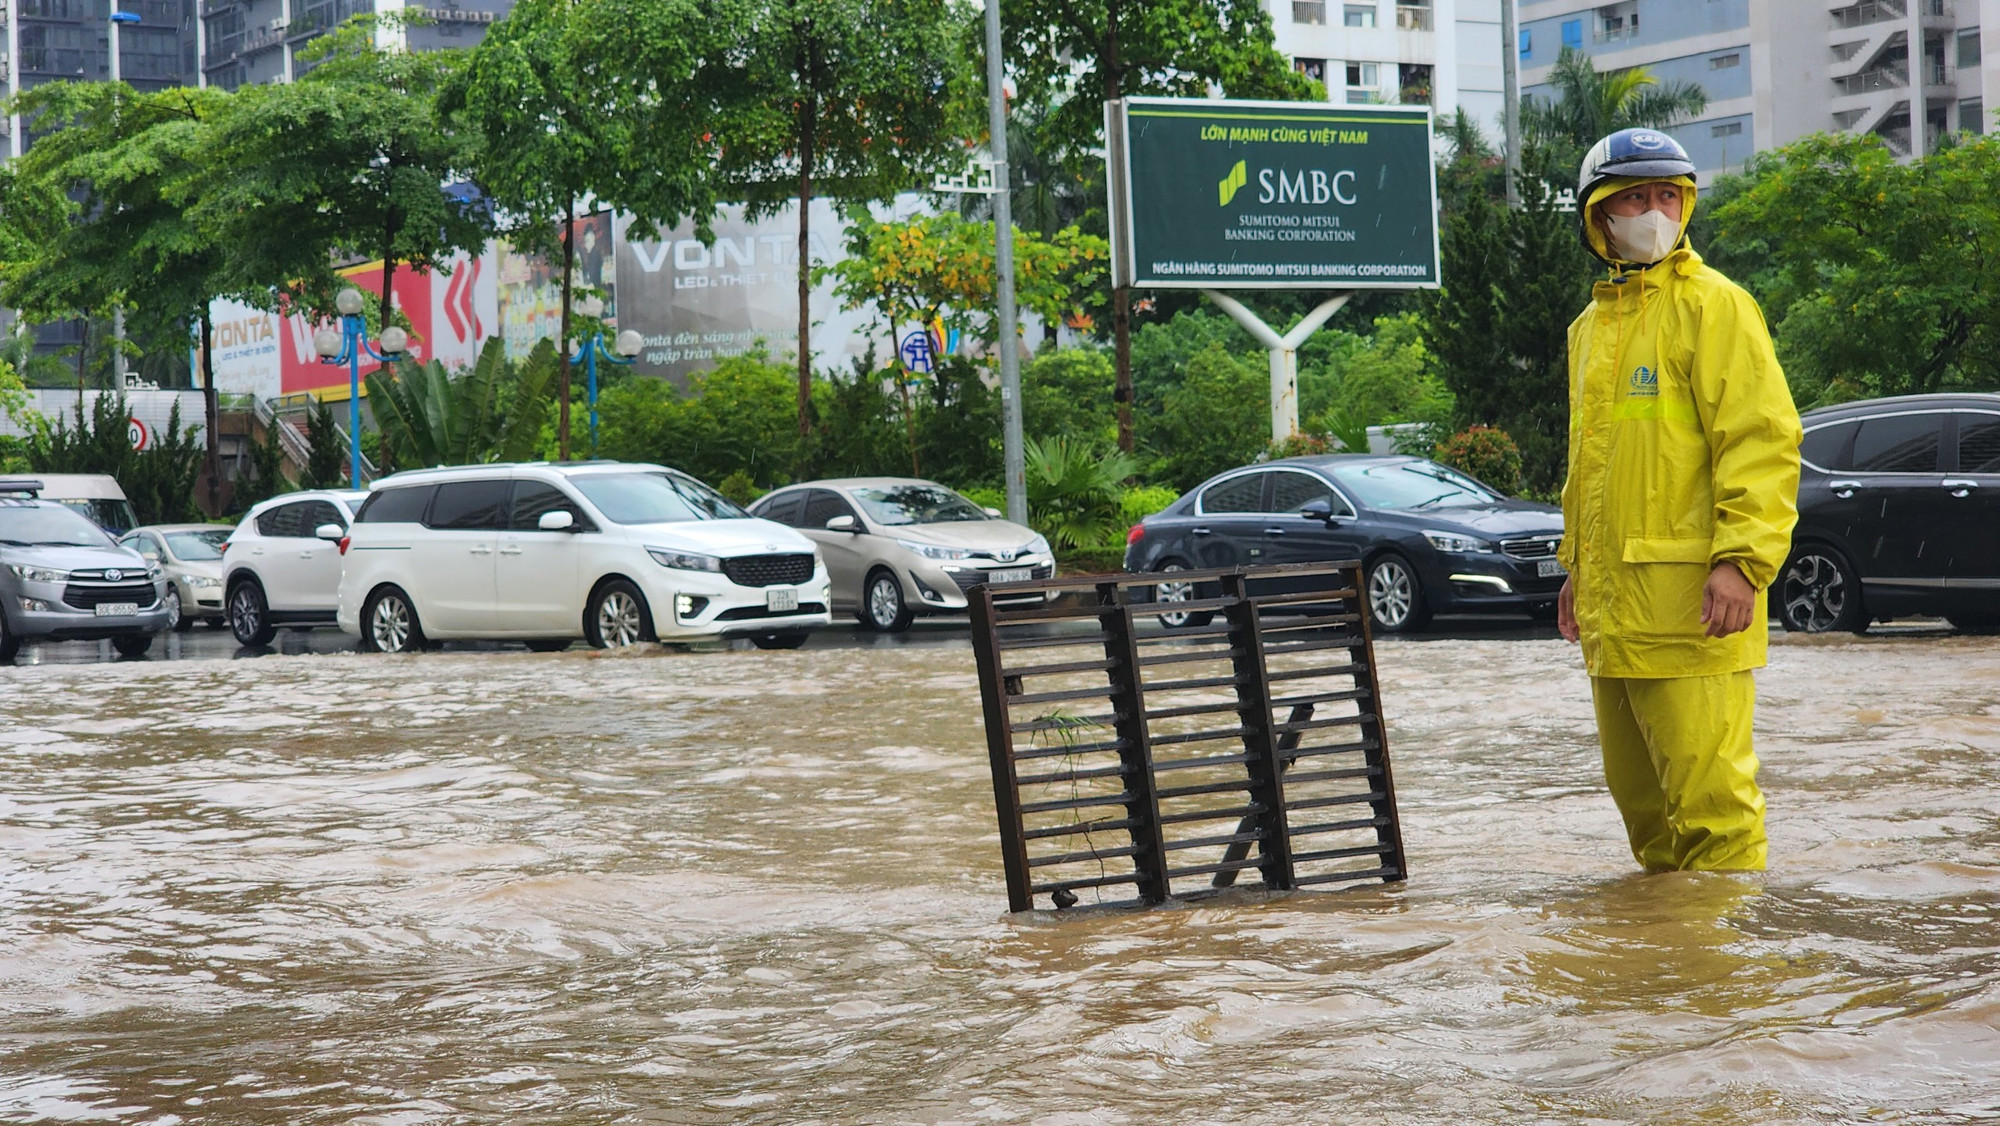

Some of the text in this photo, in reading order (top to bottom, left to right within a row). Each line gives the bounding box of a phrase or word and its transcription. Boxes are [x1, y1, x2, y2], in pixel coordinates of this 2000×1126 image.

[1201, 124, 1369, 146] LỚN MẠNH CÙNG VIỆT NAM
[1258, 168, 1357, 205] SMBC
[1239, 215, 1340, 227] SUMITOMO MITSUI
[1225, 230, 1356, 242] BANKING CORPORATION
[631, 231, 833, 273] VONTA
[1152, 261, 1427, 277] NGÂN HÀNG SUMITOMO MITSUI BANKING CORPORATION
[675, 276, 710, 290] LED
[642, 334, 672, 348] onta
